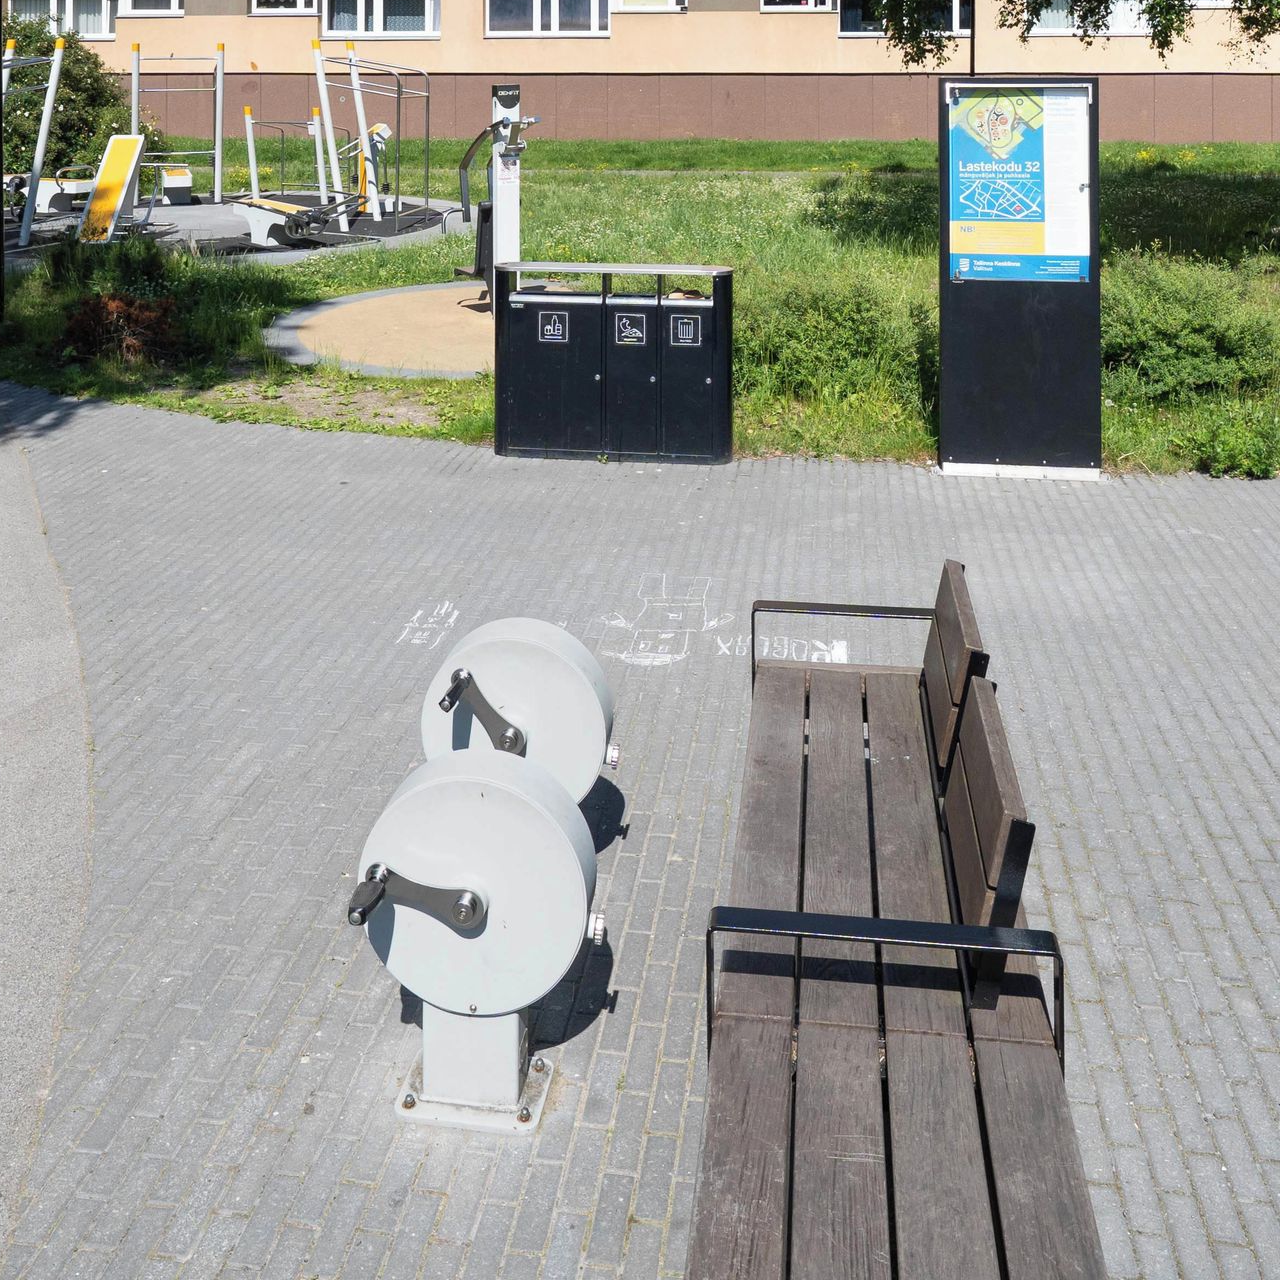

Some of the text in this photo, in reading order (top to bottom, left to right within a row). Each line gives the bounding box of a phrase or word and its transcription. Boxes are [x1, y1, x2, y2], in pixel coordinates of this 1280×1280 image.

[959, 160, 1040, 172] Lastekodu 32
[960, 225, 976, 233] NB!
